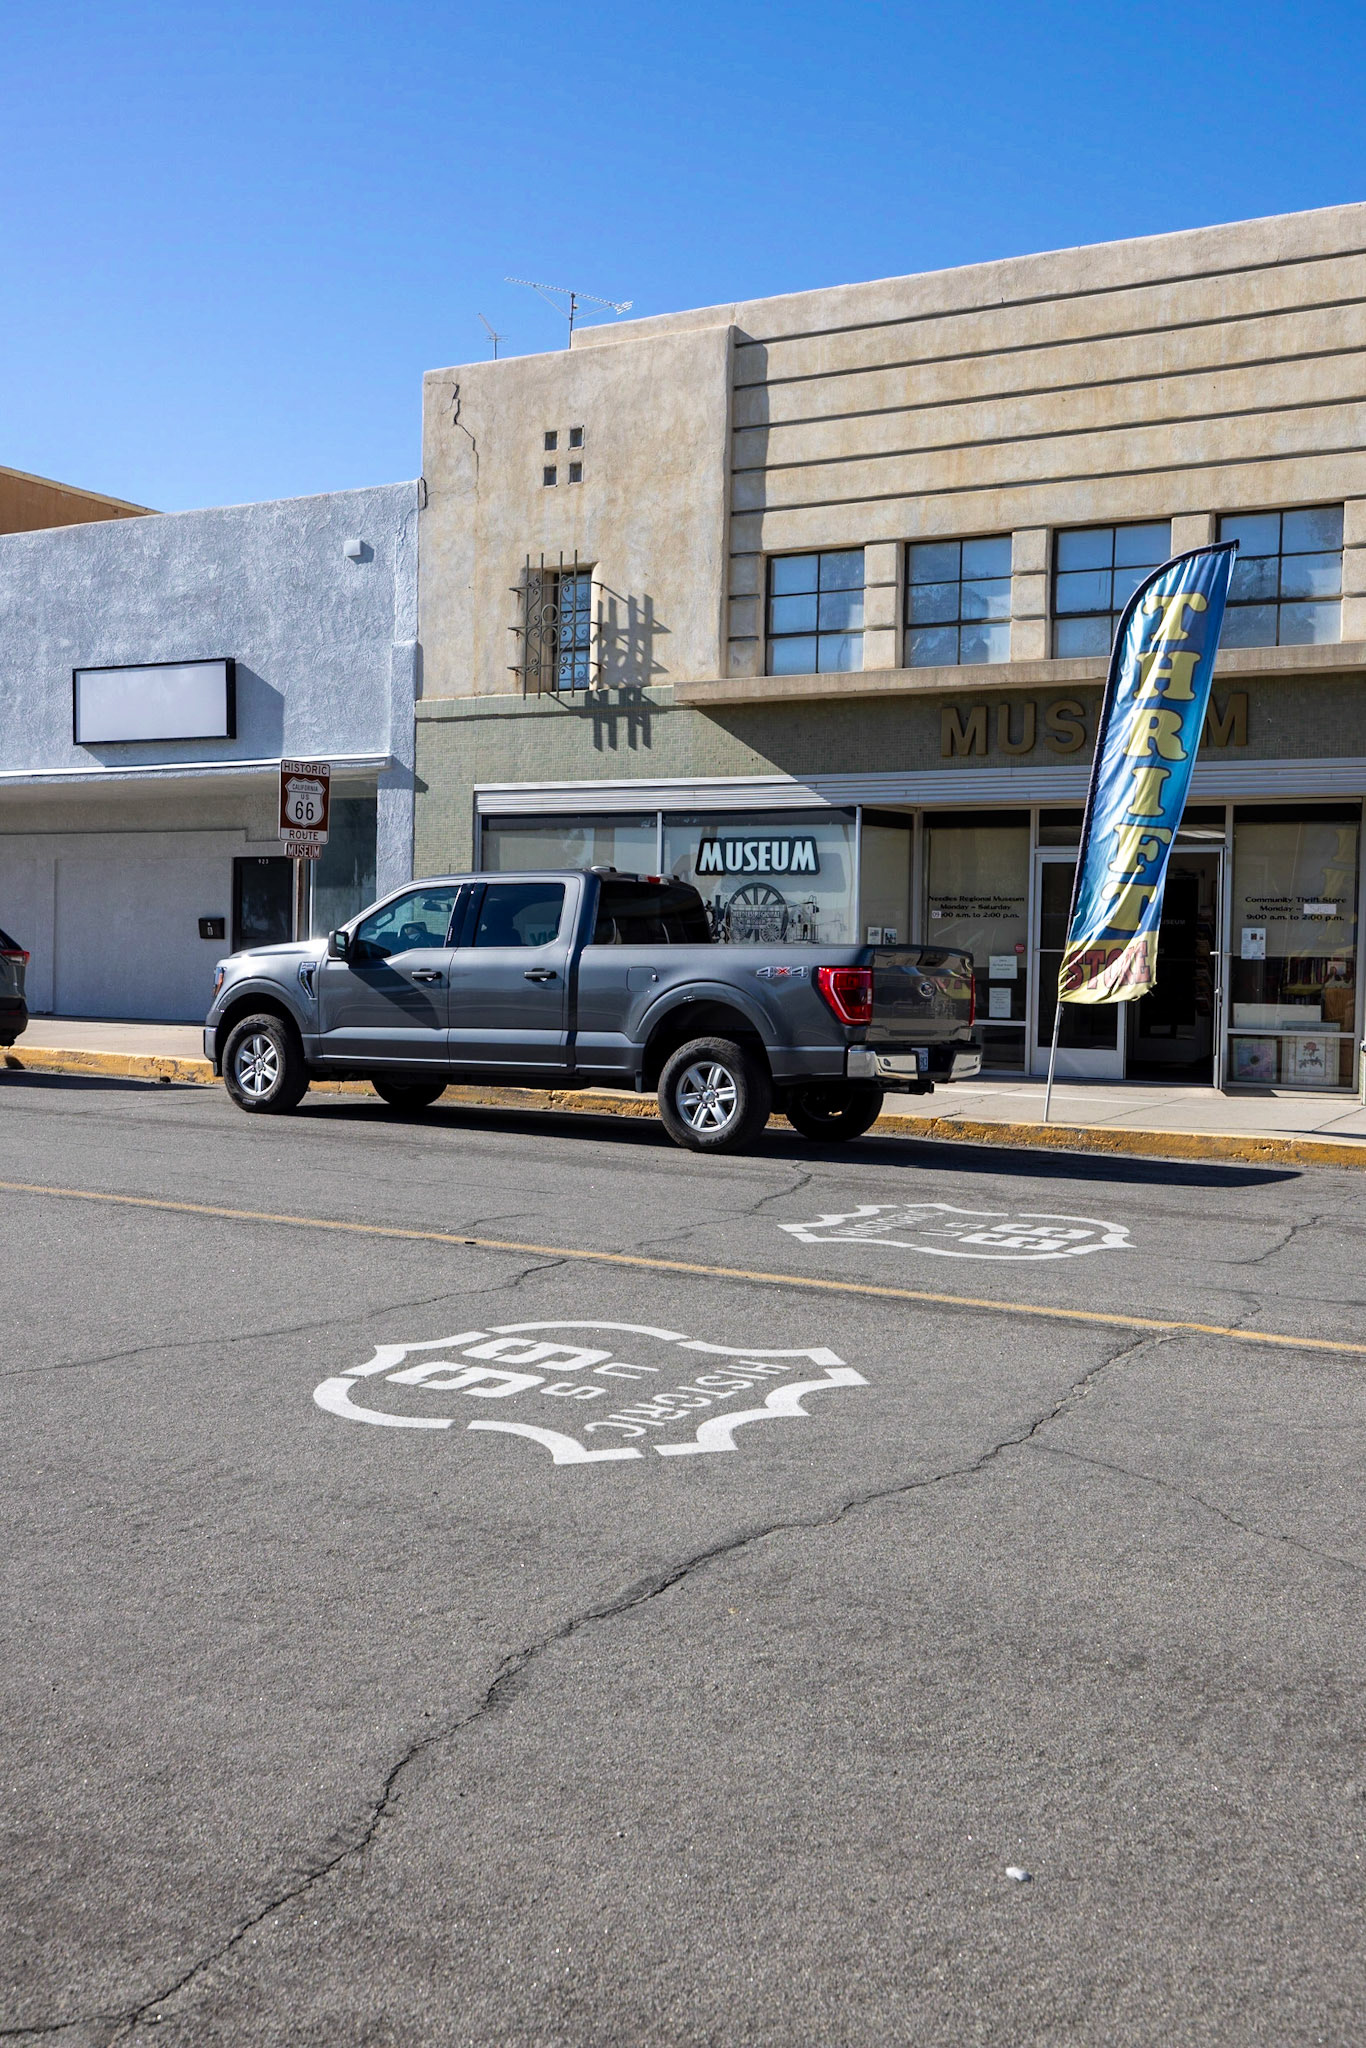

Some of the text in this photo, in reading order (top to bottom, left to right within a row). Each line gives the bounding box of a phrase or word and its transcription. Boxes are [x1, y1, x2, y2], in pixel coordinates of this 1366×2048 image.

[940, 692, 1248, 757] MUSM
[284, 762, 328, 775] HISTORIC
[1101, 591, 1209, 932] THRIFT
[292, 784, 318, 792] CALIFORNIA
[295, 801, 314, 820] 66
[289, 831, 319, 841] ROUTE
[288, 845, 320, 858] MUSEUM
[699, 841, 816, 872] MUSEUM
[1245, 896, 1293, 904] Community
[1260, 905, 1293, 913] Monday
[1065, 941, 1151, 990] STORE
[958, 1223, 1094, 1250] 66
[385, 1337, 614, 1398] 66
[583, 1360, 791, 1439] HISTORIC
